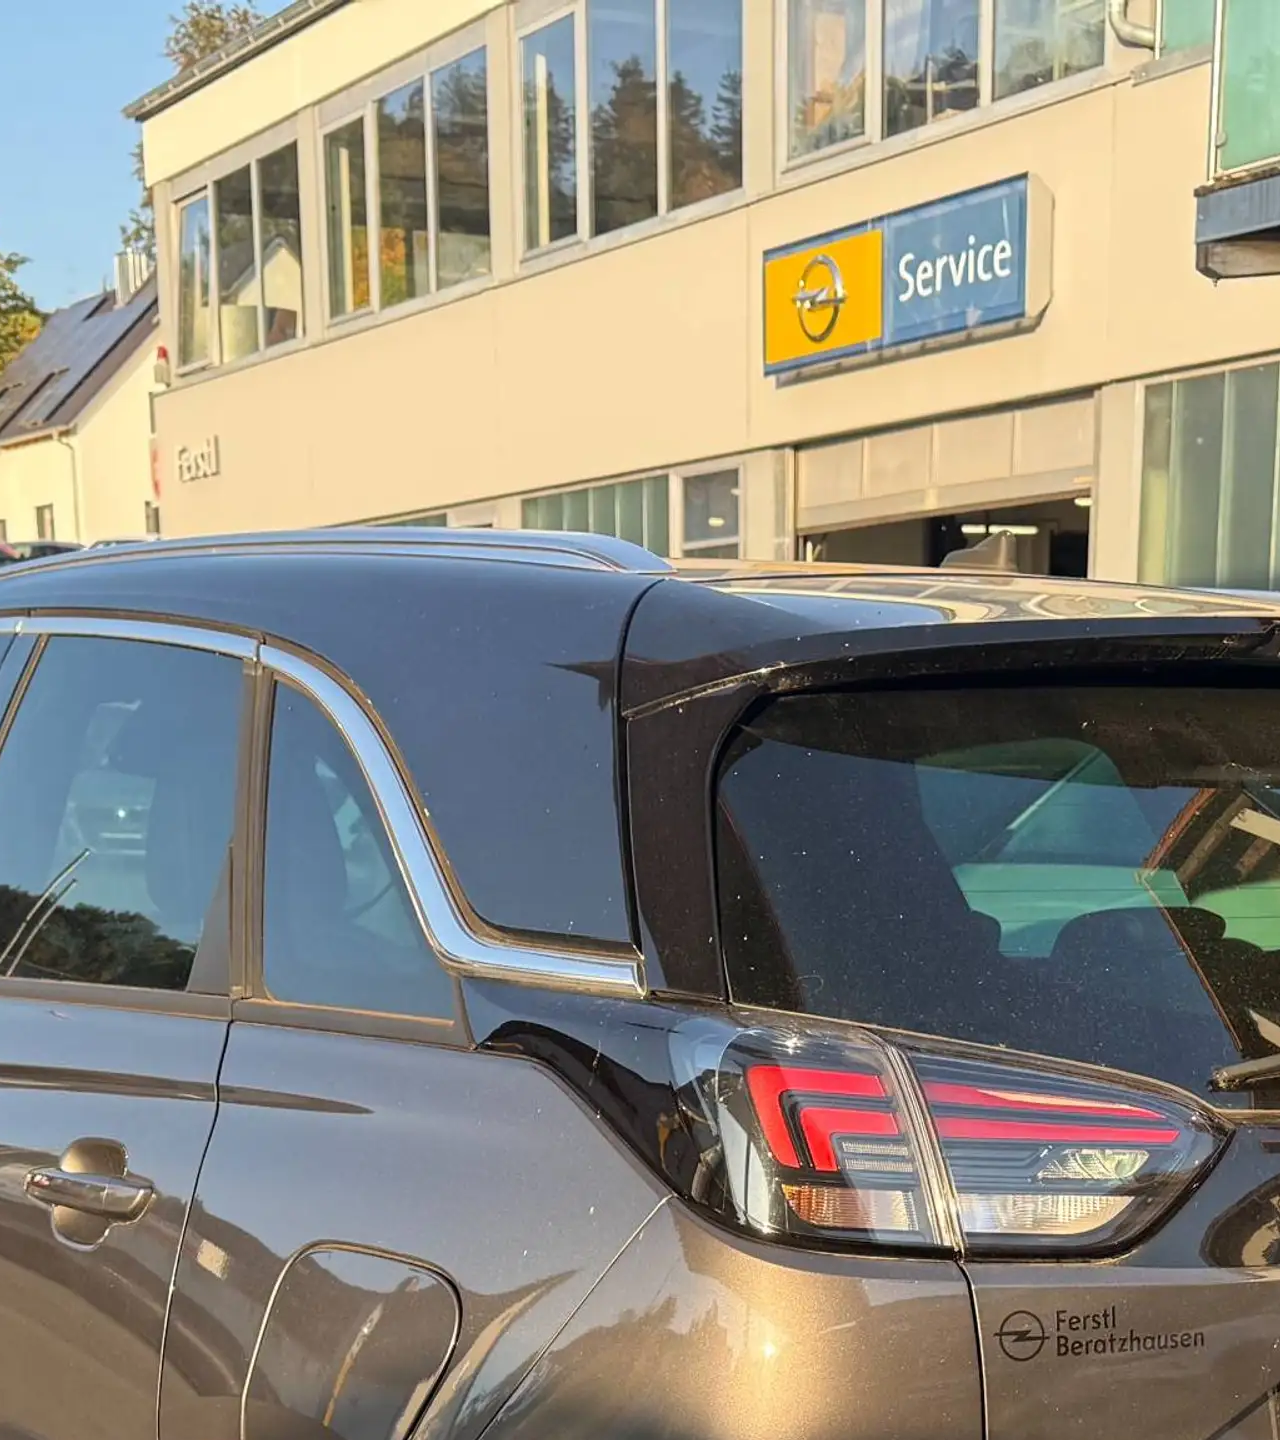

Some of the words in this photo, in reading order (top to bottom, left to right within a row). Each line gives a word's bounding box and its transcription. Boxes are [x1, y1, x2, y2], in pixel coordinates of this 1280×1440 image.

[898, 235, 1012, 303] Service
[1055, 1305, 1117, 1332] Ferstl
[1055, 1329, 1206, 1357] Beratzhausen
